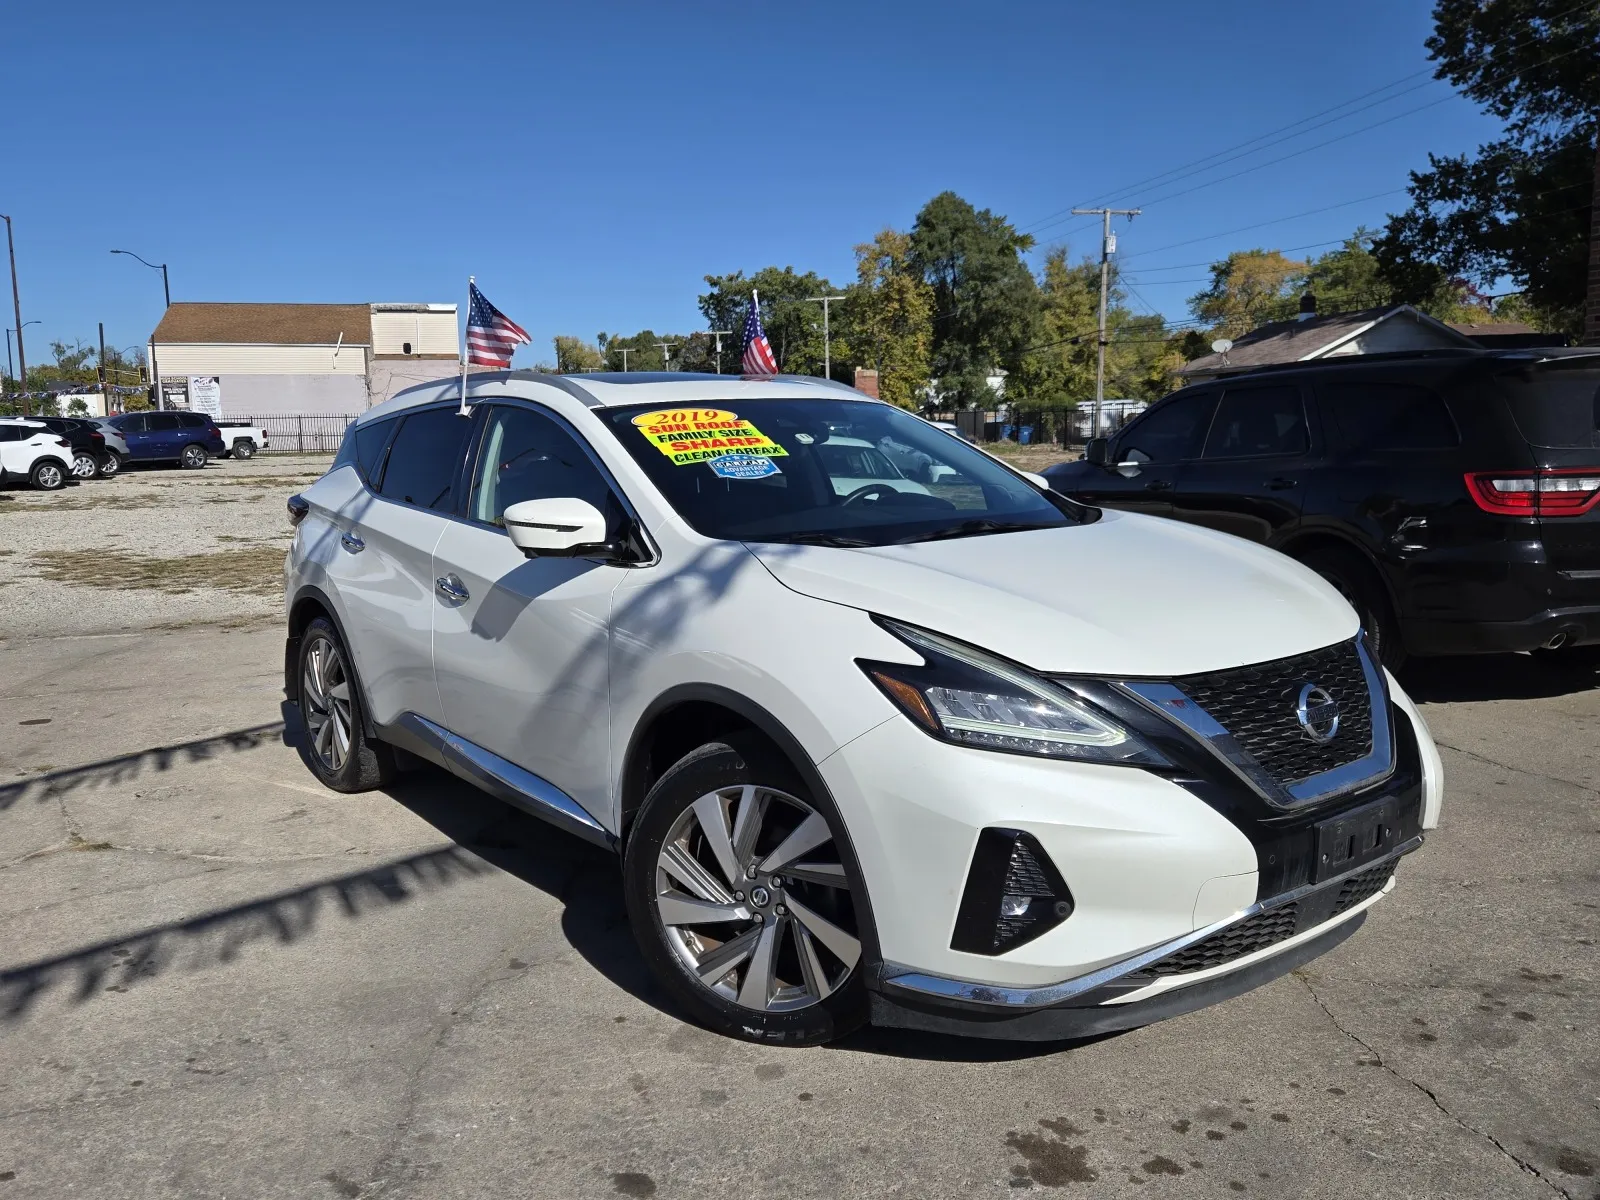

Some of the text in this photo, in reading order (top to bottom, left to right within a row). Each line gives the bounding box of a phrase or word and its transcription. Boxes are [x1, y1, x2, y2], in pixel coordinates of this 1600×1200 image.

[655, 410, 719, 425] 2019
[648, 421, 745, 434] SUN ROOF
[657, 428, 752, 443] FAMILY SIZE
[670, 437, 763, 452] SHARP
[674, 446, 781, 463] CLEAN CARFAX
[713, 459, 769, 468] CARFAX
[724, 464, 770, 473] ADVANTAGE
